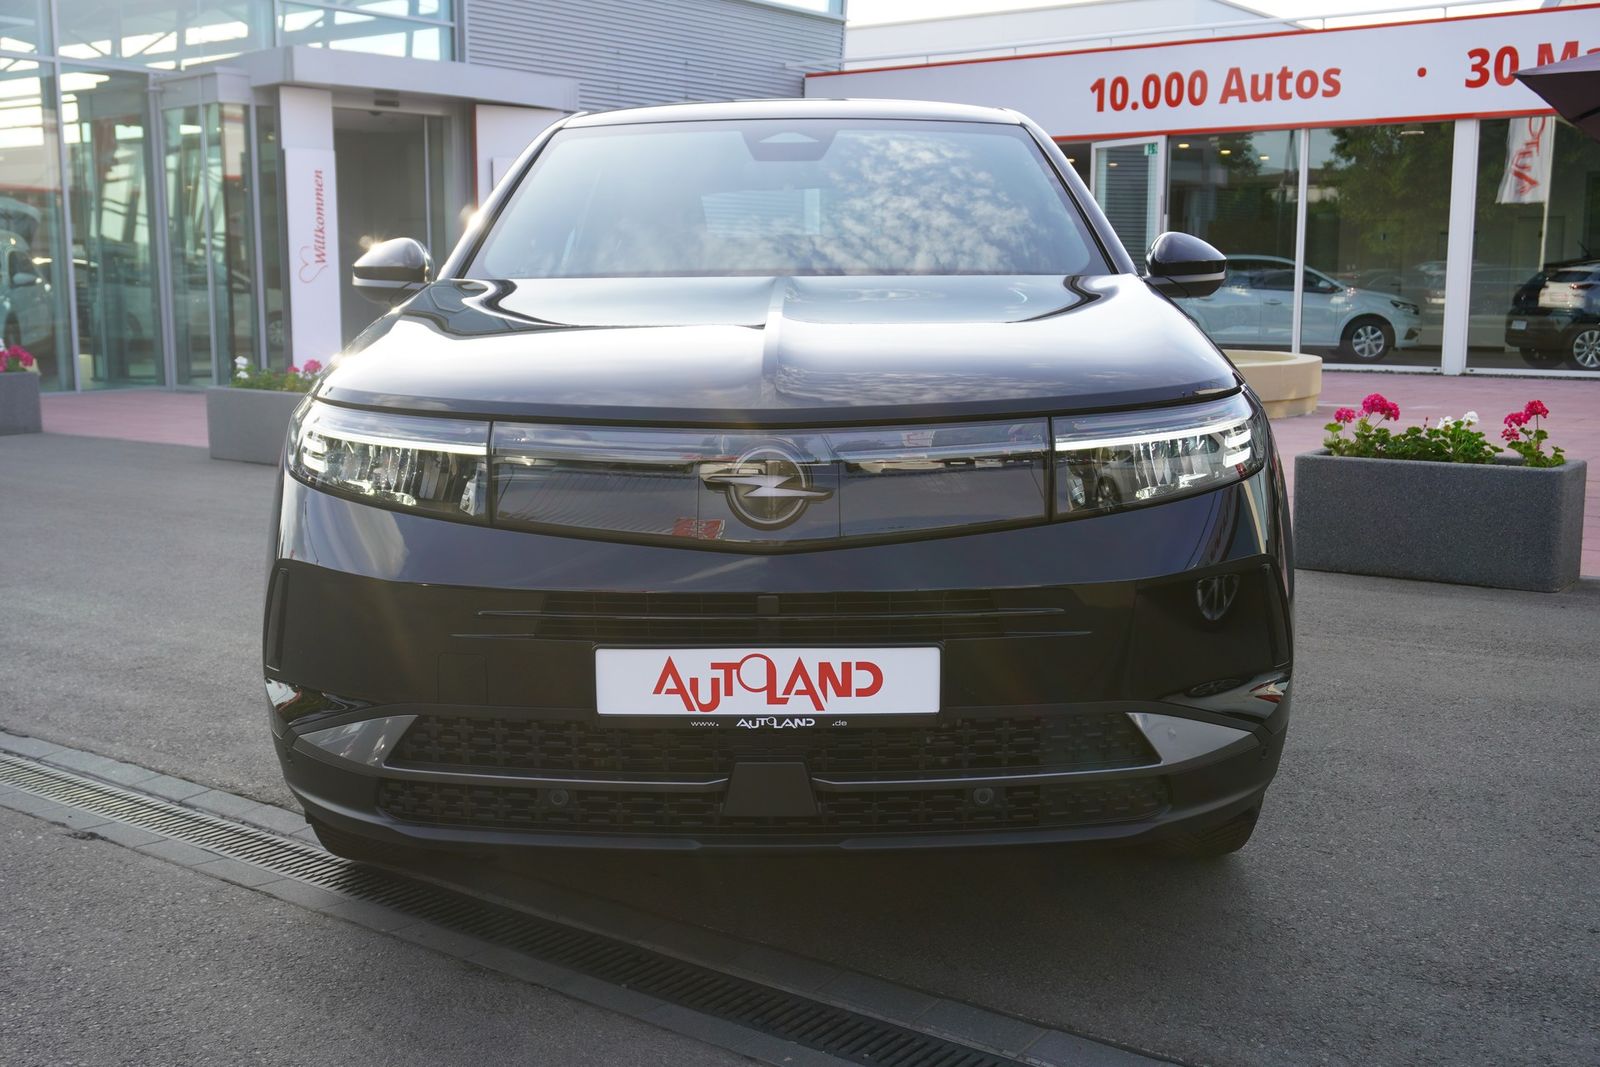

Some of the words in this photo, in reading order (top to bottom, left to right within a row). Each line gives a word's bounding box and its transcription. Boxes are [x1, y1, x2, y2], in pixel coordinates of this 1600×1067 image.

[1089, 69, 1209, 113] 10.000
[1218, 65, 1342, 105] Autos
[1464, 45, 1520, 89] 30
[313, 169, 327, 264] Willkommen
